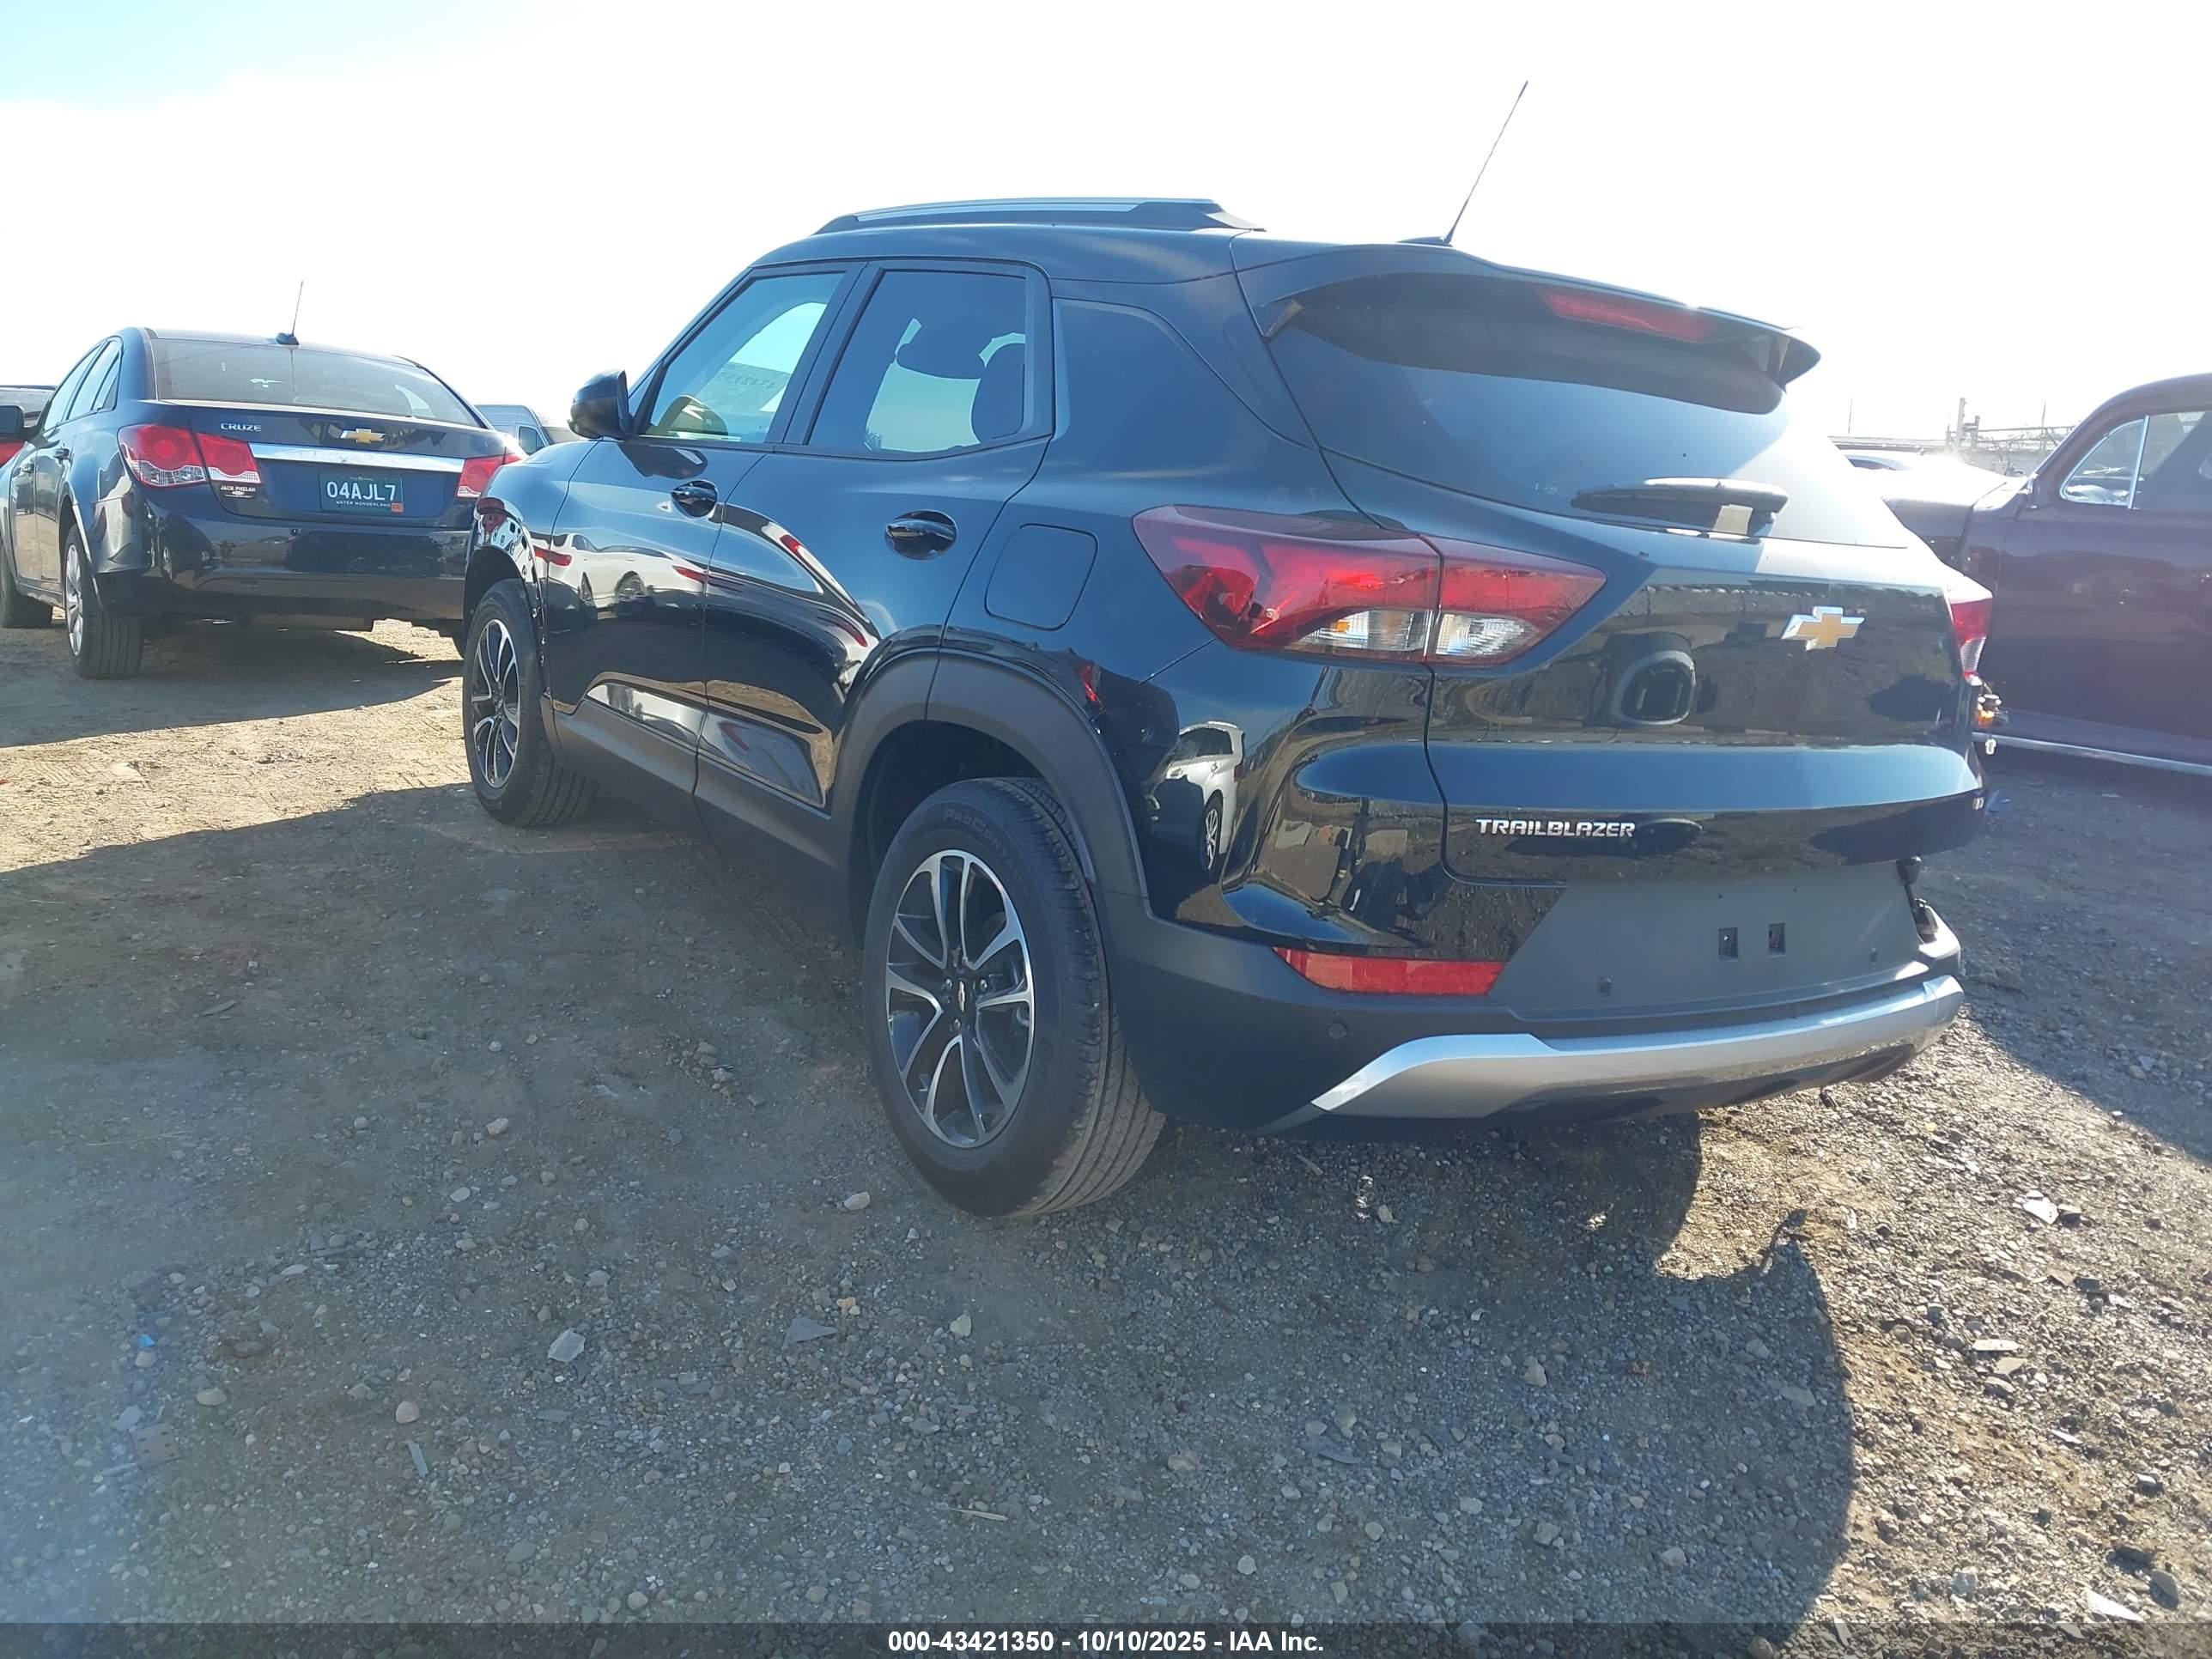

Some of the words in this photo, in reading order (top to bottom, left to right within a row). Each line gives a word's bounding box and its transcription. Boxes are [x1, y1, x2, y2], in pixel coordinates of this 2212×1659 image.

[220, 422, 262, 432] CRUZE
[326, 481, 396, 501] 04AJL7
[1475, 818, 1636, 837] TRAILBLAZER
